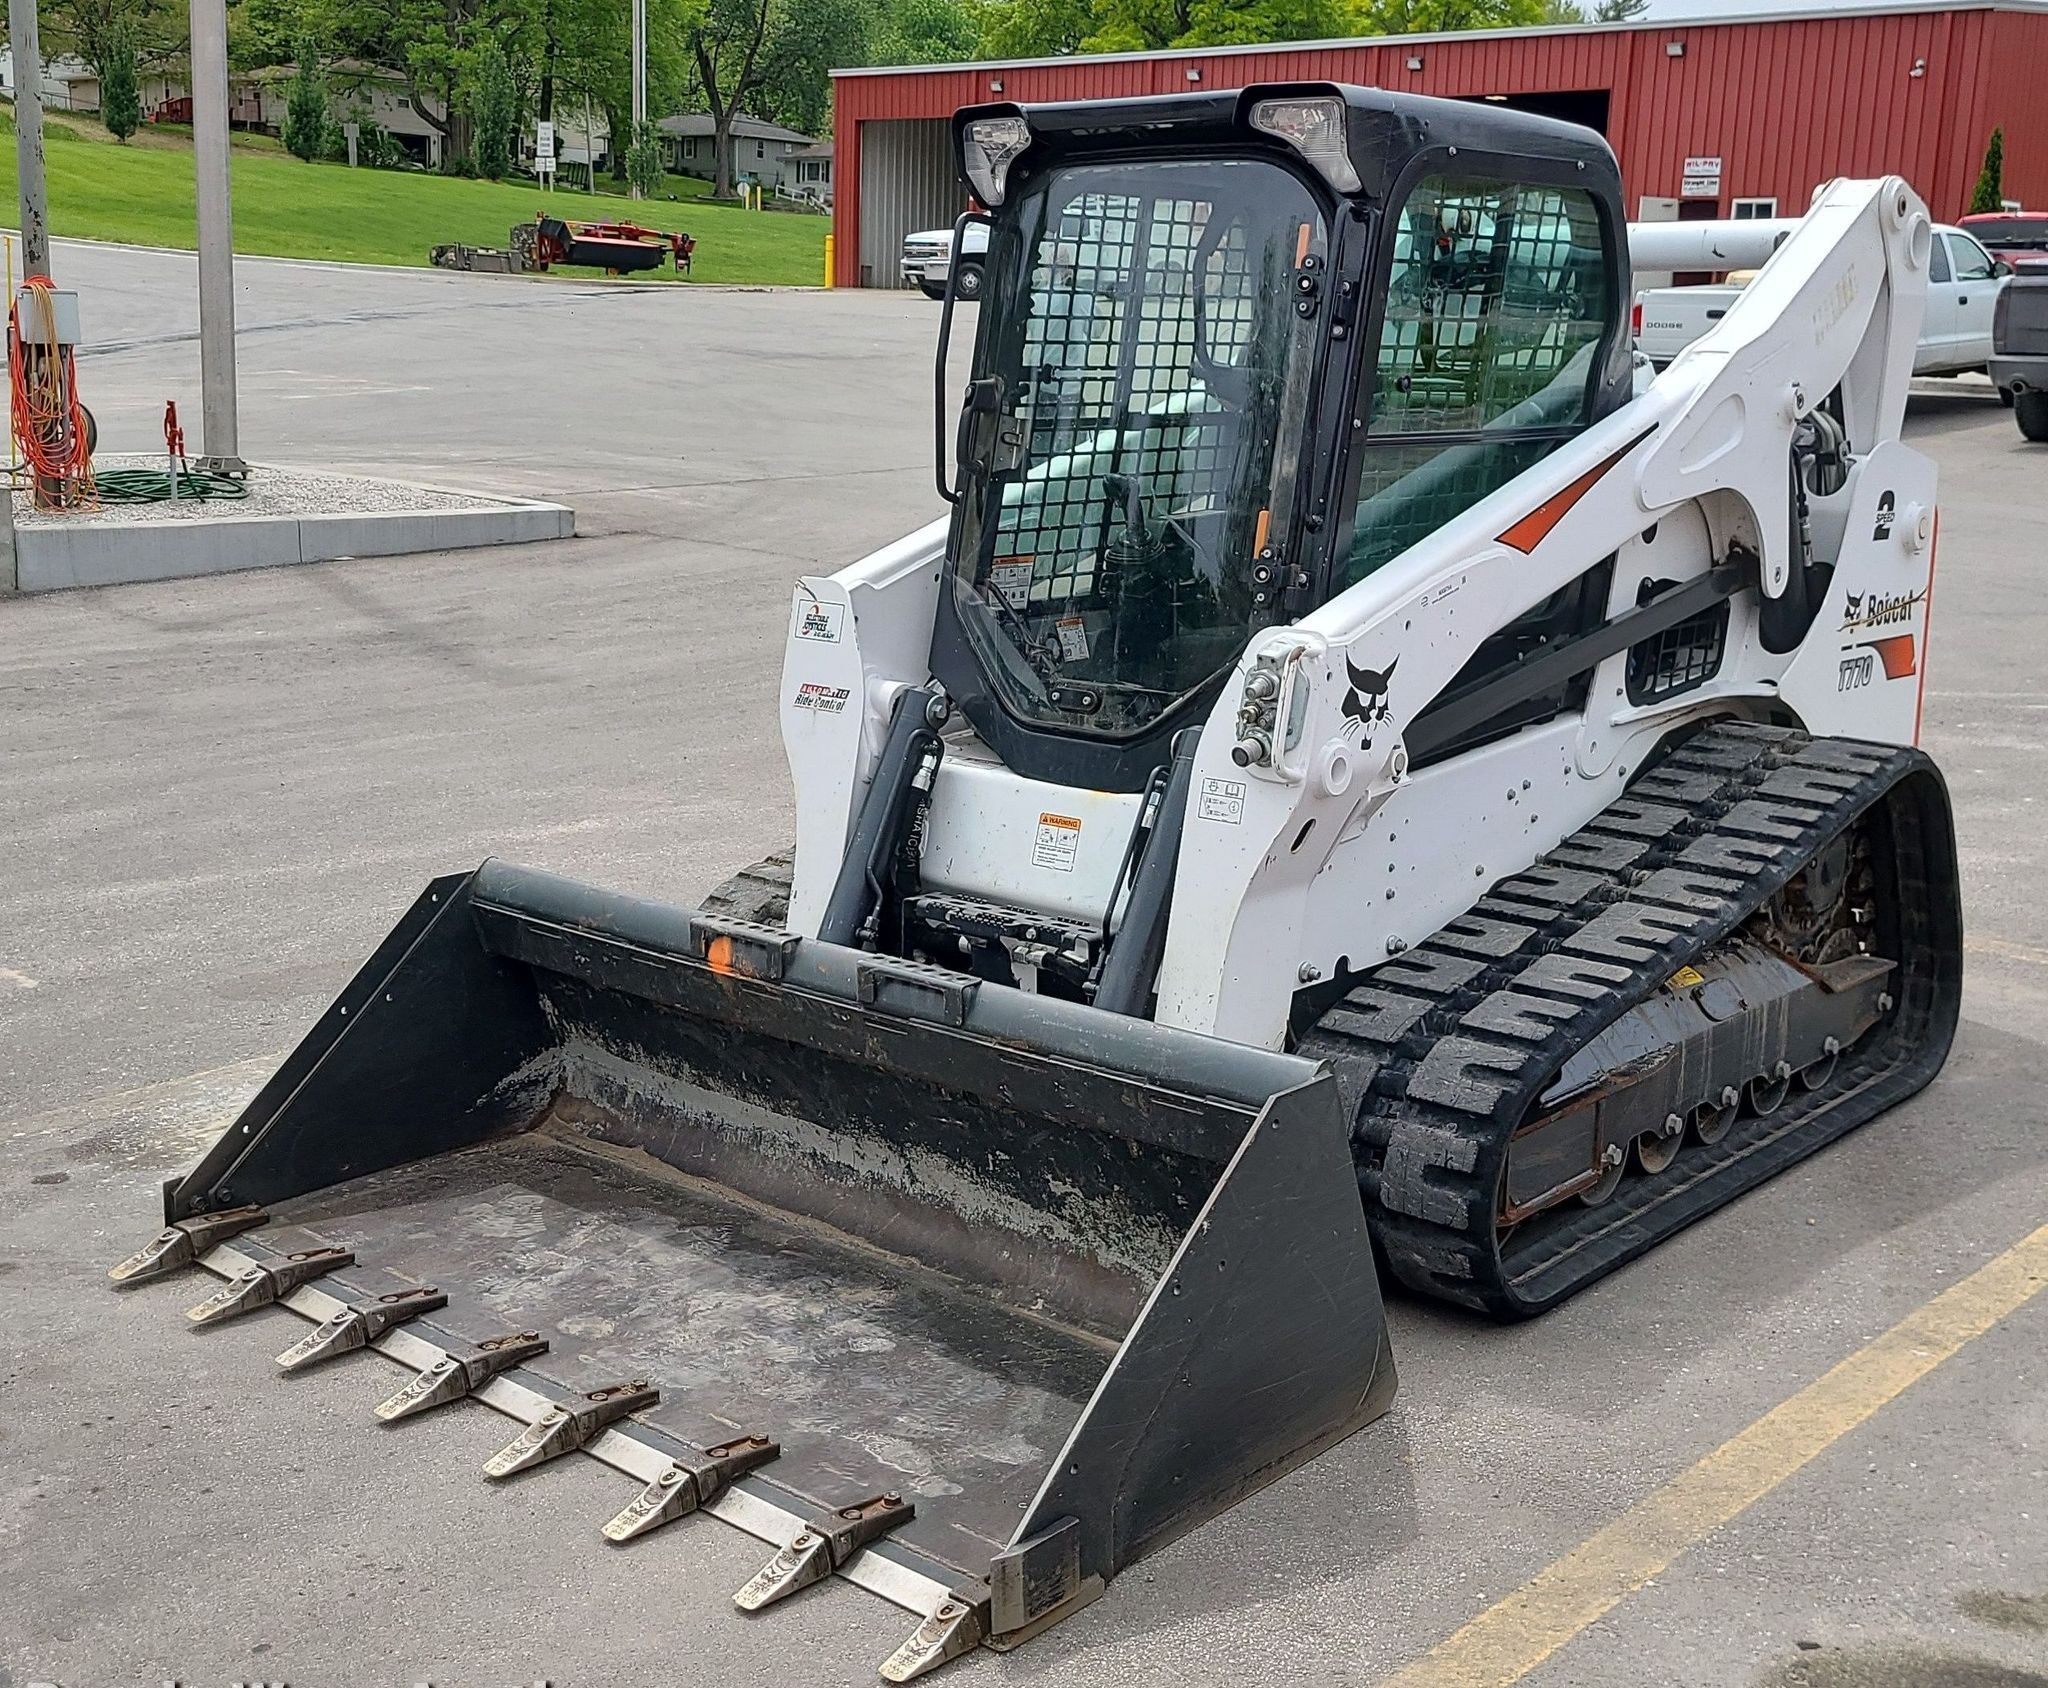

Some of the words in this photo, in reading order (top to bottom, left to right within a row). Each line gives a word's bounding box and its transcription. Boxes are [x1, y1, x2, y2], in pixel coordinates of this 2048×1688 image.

[1872, 490, 1895, 541] 2
[1875, 512, 1895, 523] SPEED
[1867, 589, 1913, 627] Bobcat
[1838, 655, 1873, 692] T770
[794, 692, 814, 706] Ride
[814, 697, 846, 711] Control
[1049, 816, 1078, 827] WARNING
